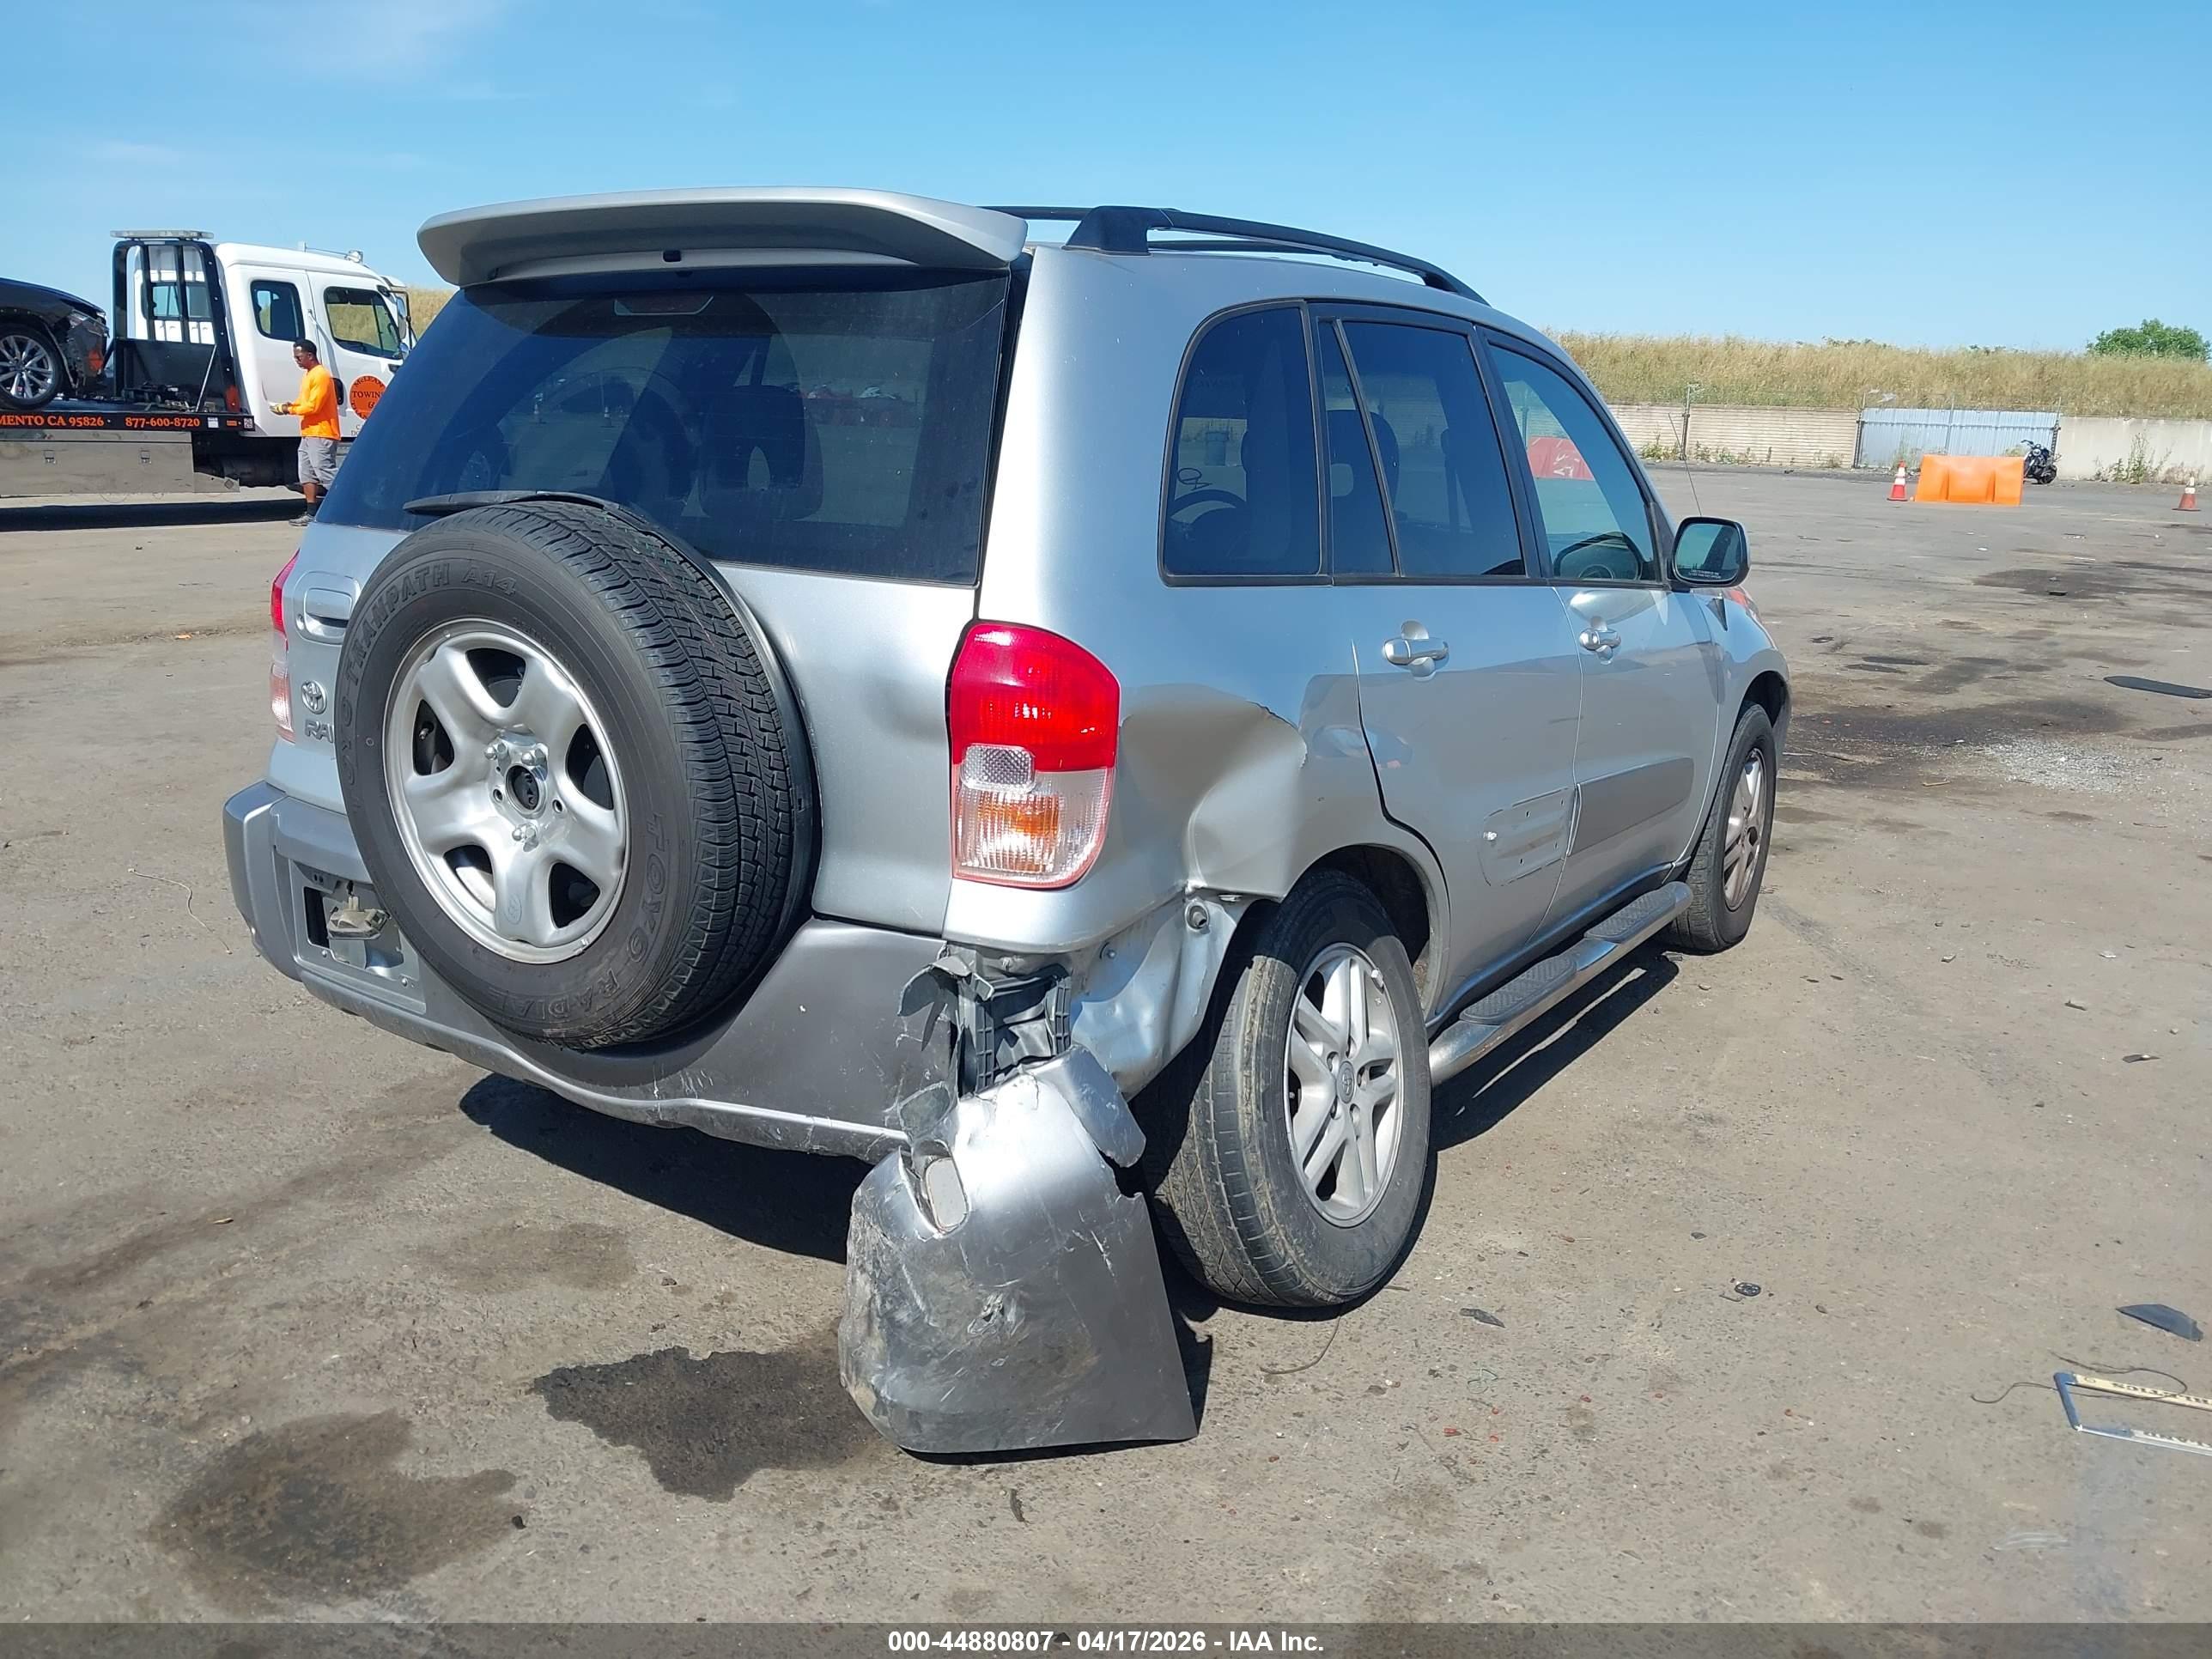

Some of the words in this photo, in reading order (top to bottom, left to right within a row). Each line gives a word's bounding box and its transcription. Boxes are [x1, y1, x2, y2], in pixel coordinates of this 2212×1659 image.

[47, 416, 67, 426] CA
[69, 416, 104, 428] 95826
[125, 417, 200, 428] 877-600-8720
[461, 566, 517, 597] A14
[627, 812, 666, 962] TOYO
